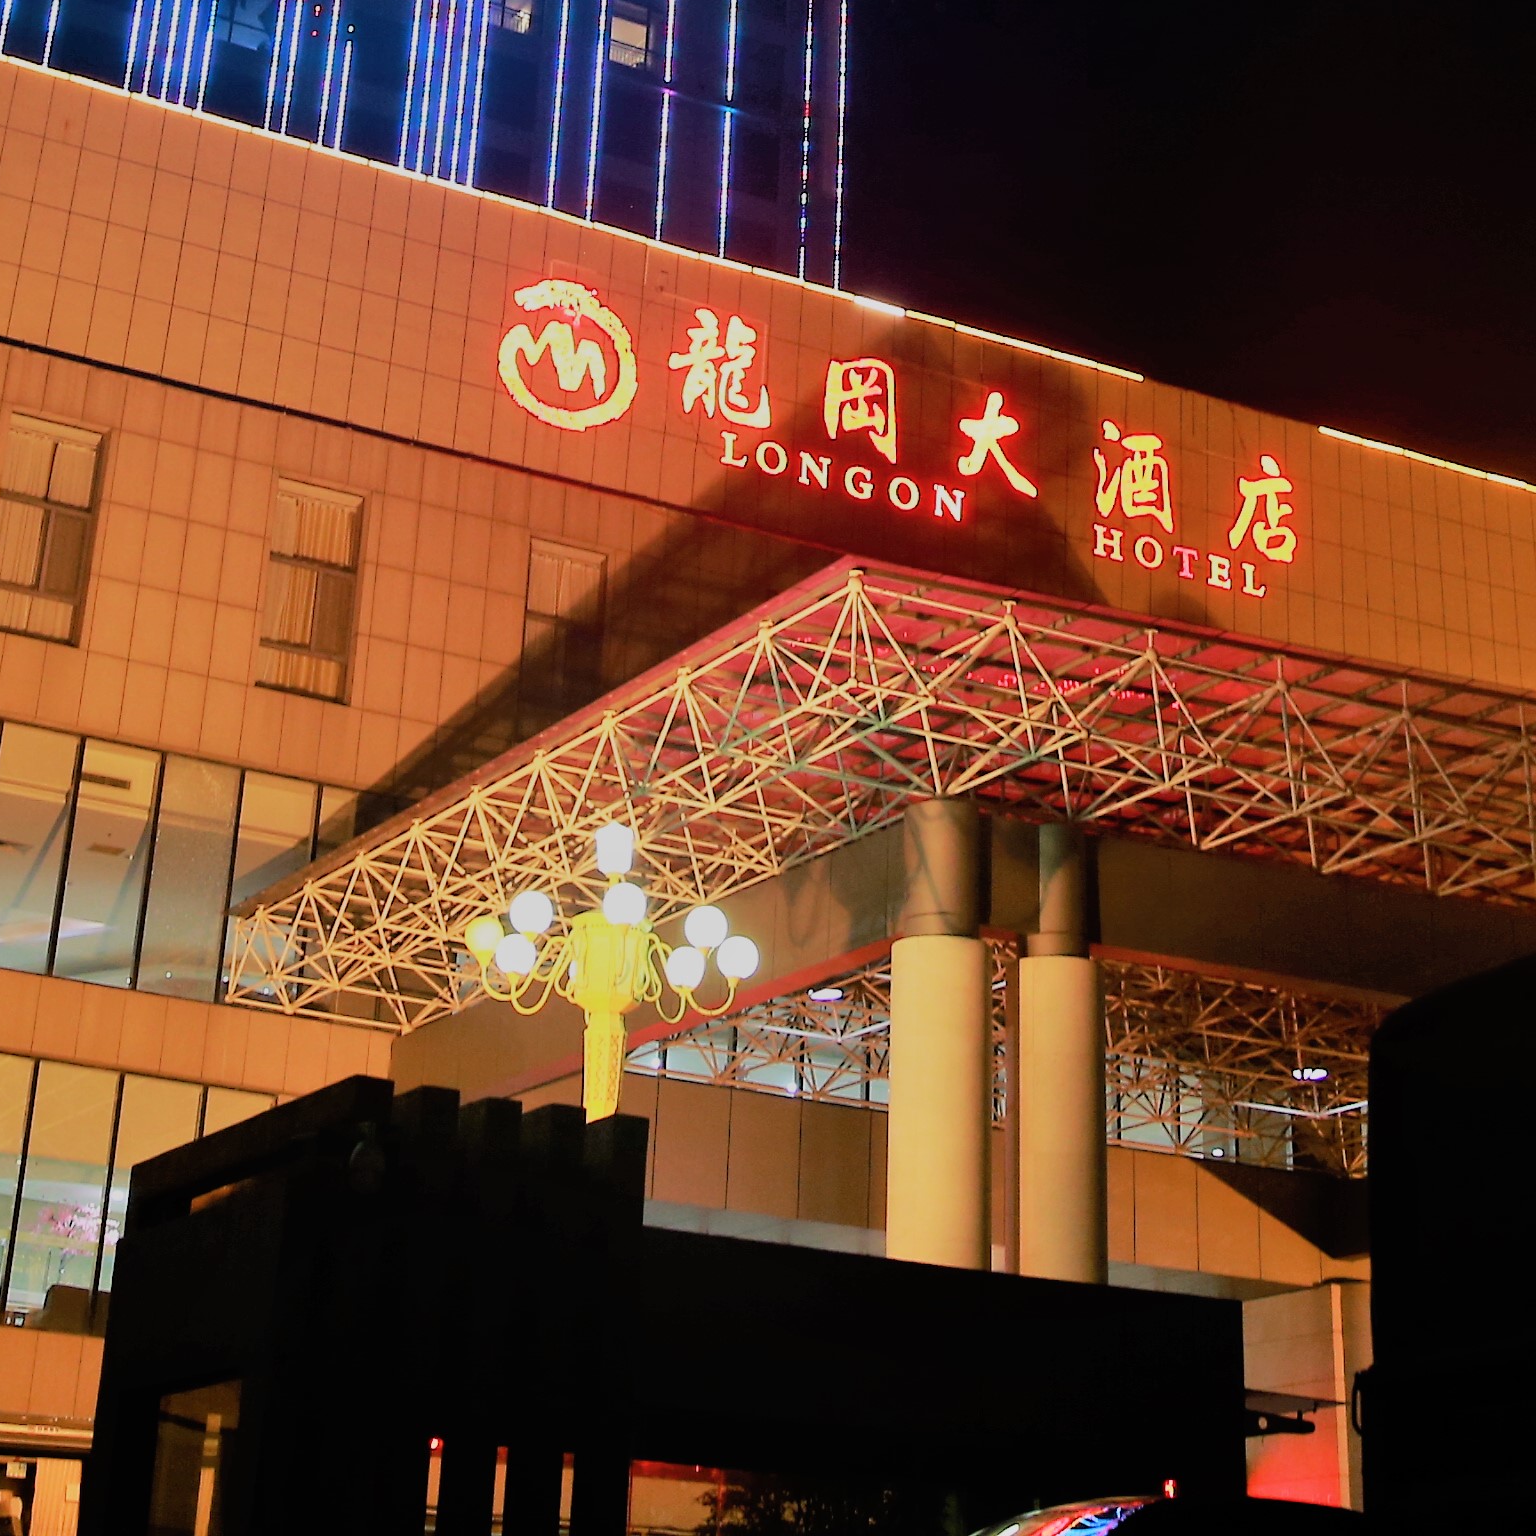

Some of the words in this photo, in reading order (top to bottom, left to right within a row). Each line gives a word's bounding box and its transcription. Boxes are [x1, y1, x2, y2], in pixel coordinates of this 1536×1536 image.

[668, 308, 1297, 562] 龍岡大酒店
[720, 431, 965, 522] LONGON
[1093, 524, 1267, 597] HOTEL
